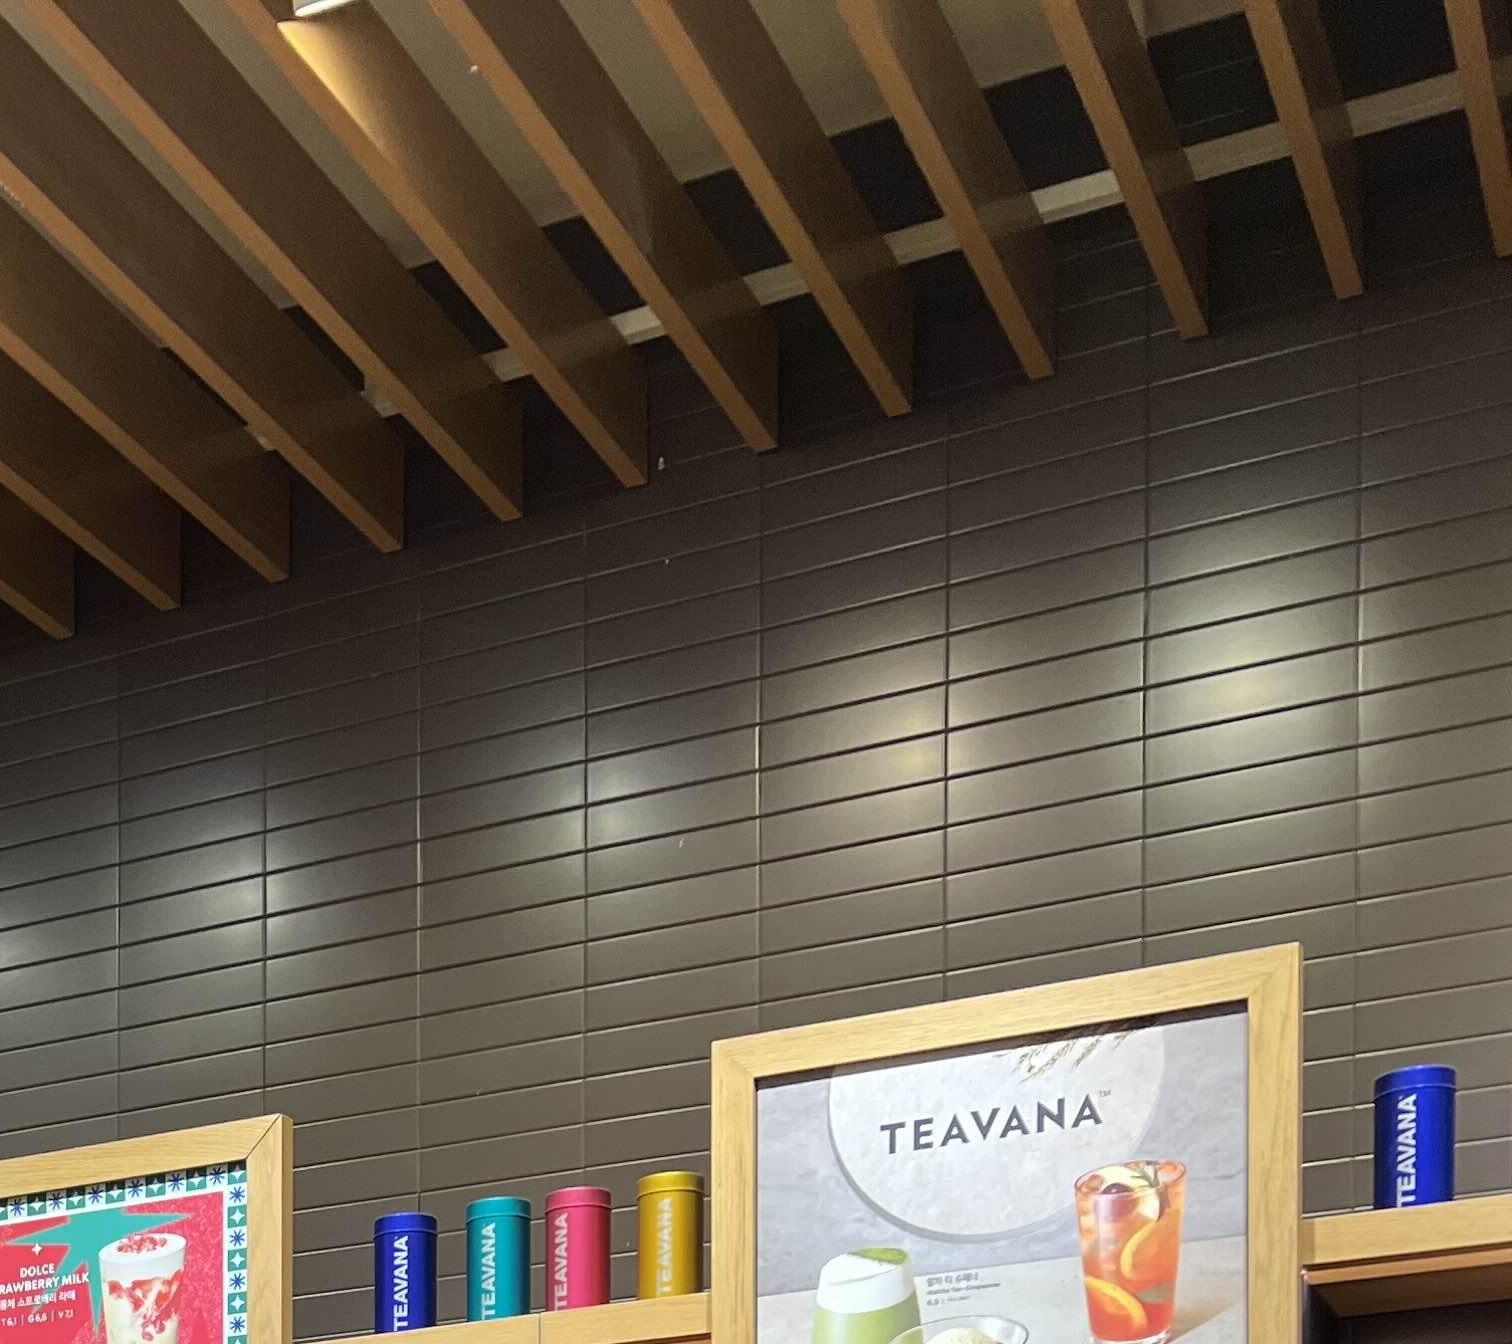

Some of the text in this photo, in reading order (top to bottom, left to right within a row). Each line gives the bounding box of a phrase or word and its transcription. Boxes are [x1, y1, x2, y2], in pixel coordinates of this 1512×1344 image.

[1397, 1094, 1419, 1207] TEAVANA
[20, 1264, 55, 1278] DOLCE
[62, 1272, 89, 1286] MILK
[393, 1235, 409, 1332] TEAVANA
[482, 1222, 496, 1321] TEAVANA
[554, 1212, 569, 1311] TEAVANA
[657, 1198, 672, 1298] TEAVANA
